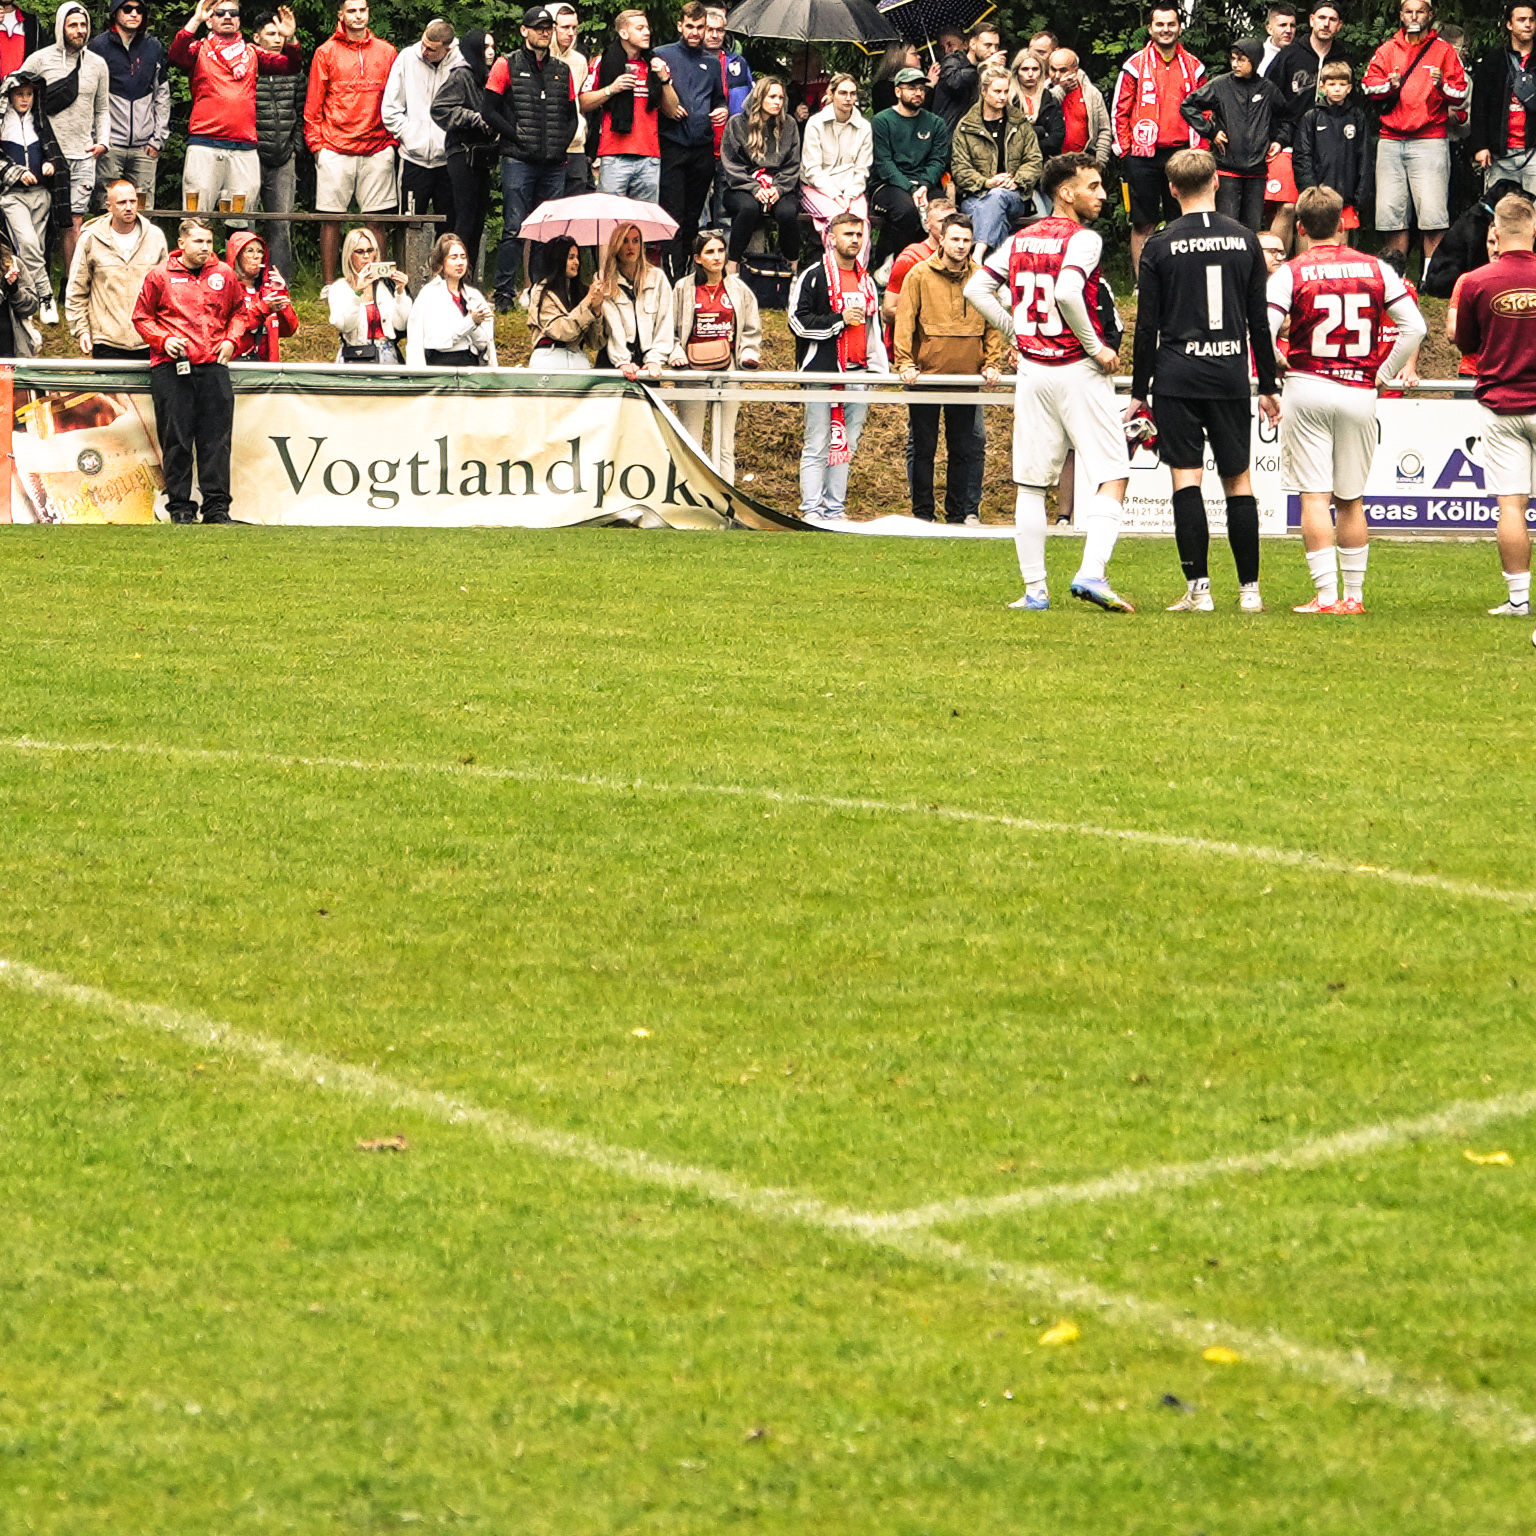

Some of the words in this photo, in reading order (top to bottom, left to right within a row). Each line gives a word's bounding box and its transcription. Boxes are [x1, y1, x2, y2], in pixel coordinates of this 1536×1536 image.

[1171, 239, 1187, 255] FC
[1189, 237, 1247, 252] FORTUNA
[1014, 272, 1063, 337] 23
[1206, 265, 1223, 330] 1
[1311, 293, 1373, 358] 25
[1185, 340, 1241, 357] PLAUEN
[268, 434, 704, 510] Vogtlandpok
